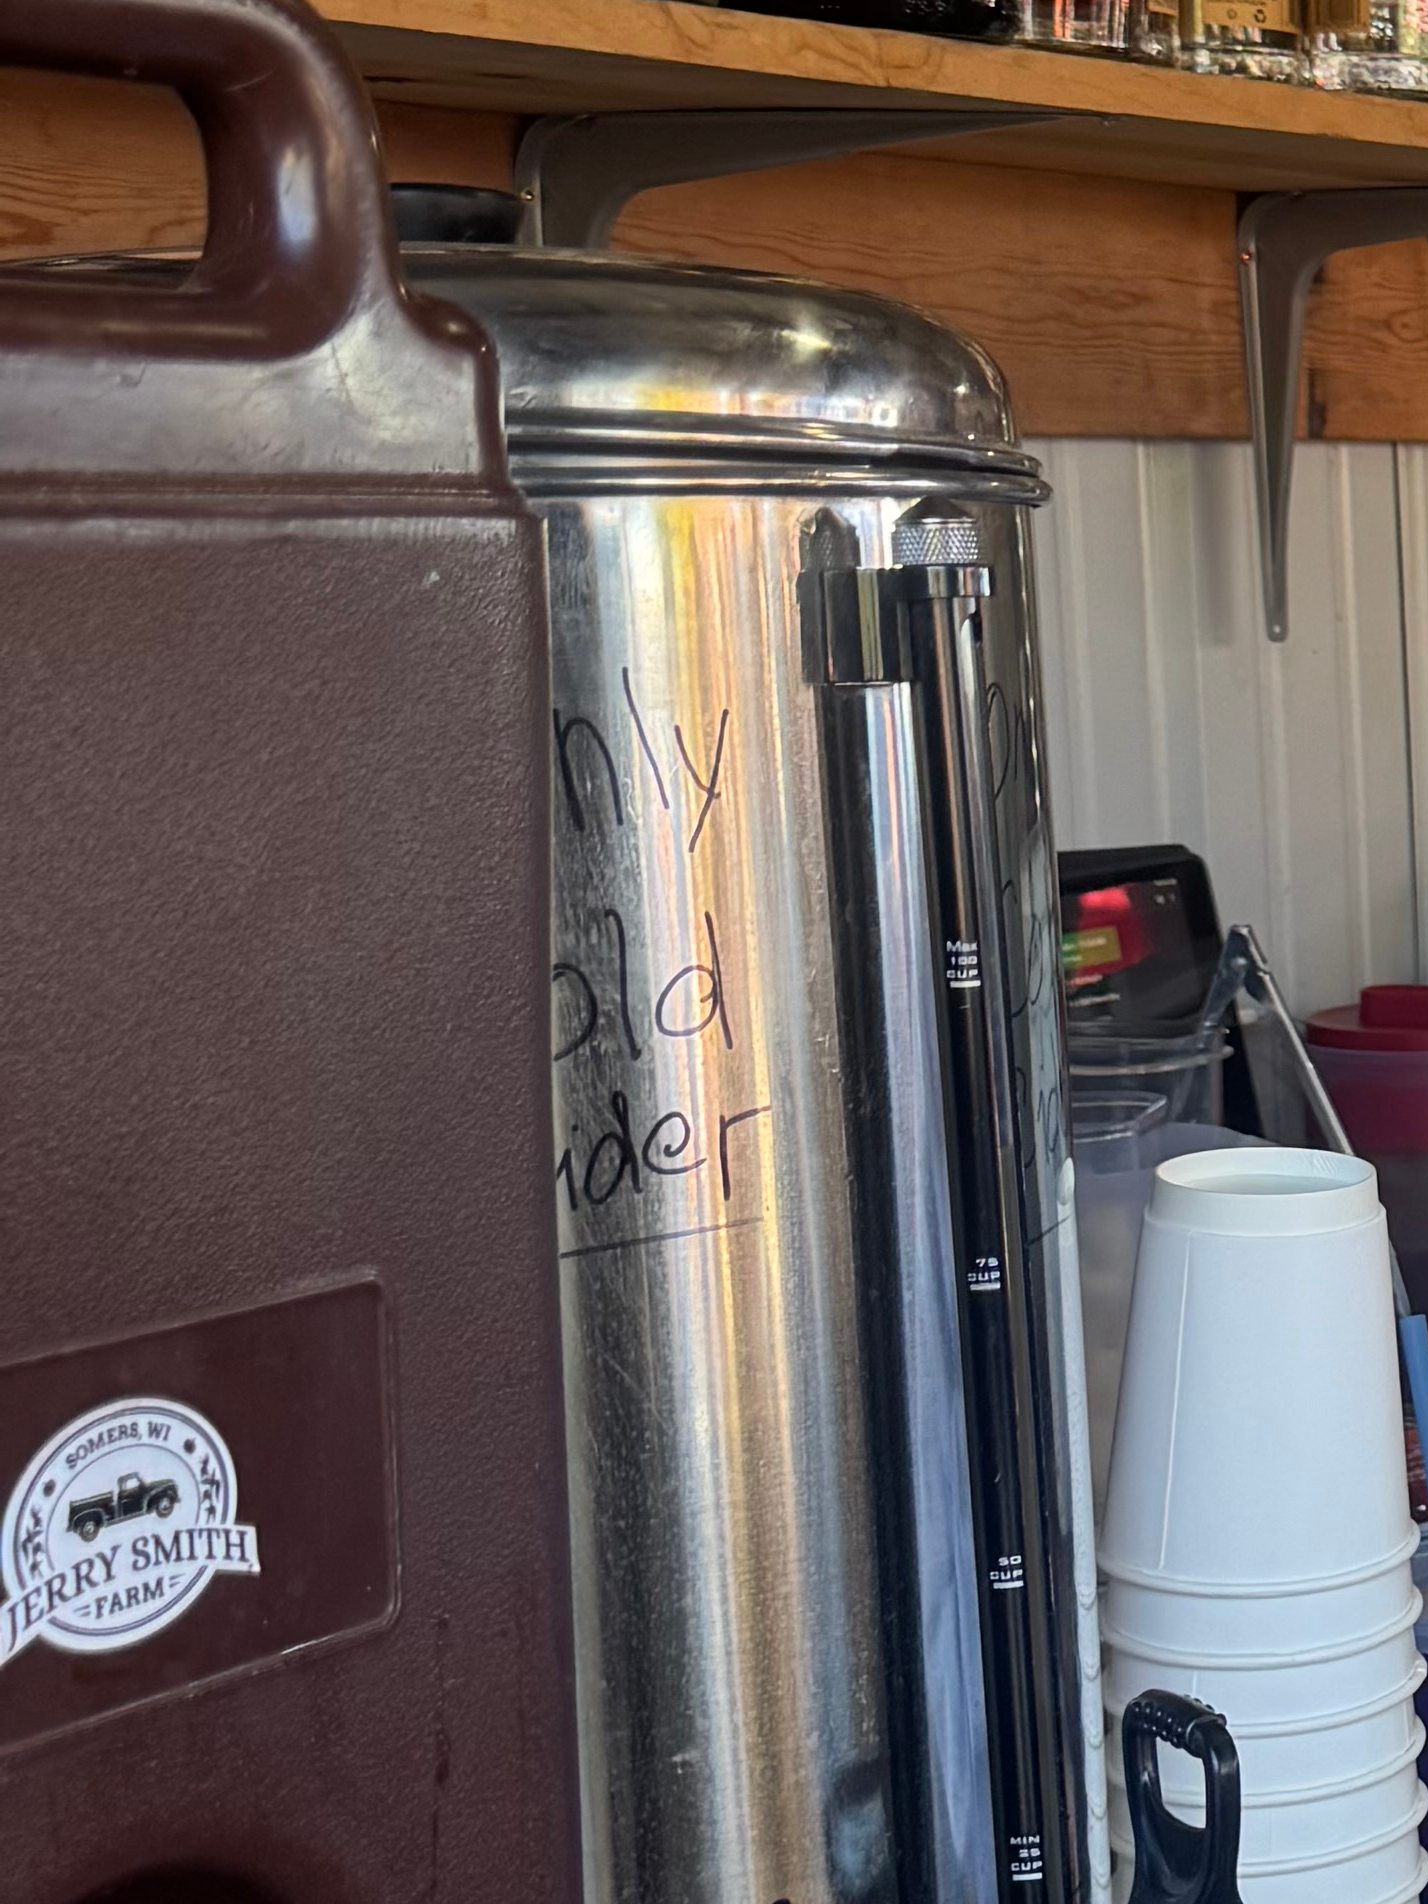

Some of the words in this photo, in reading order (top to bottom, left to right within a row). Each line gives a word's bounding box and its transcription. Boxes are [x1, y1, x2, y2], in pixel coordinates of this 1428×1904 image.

[65, 1421, 143, 1470] SOMERS,
[148, 1421, 171, 1441] WI
[7, 1544, 121, 1653] JERRY
[131, 1528, 251, 1573] SMITH
[95, 1574, 165, 1620] FARM
[1010, 1835, 1041, 1846] MIN
[1010, 1860, 1043, 1872] CUP
